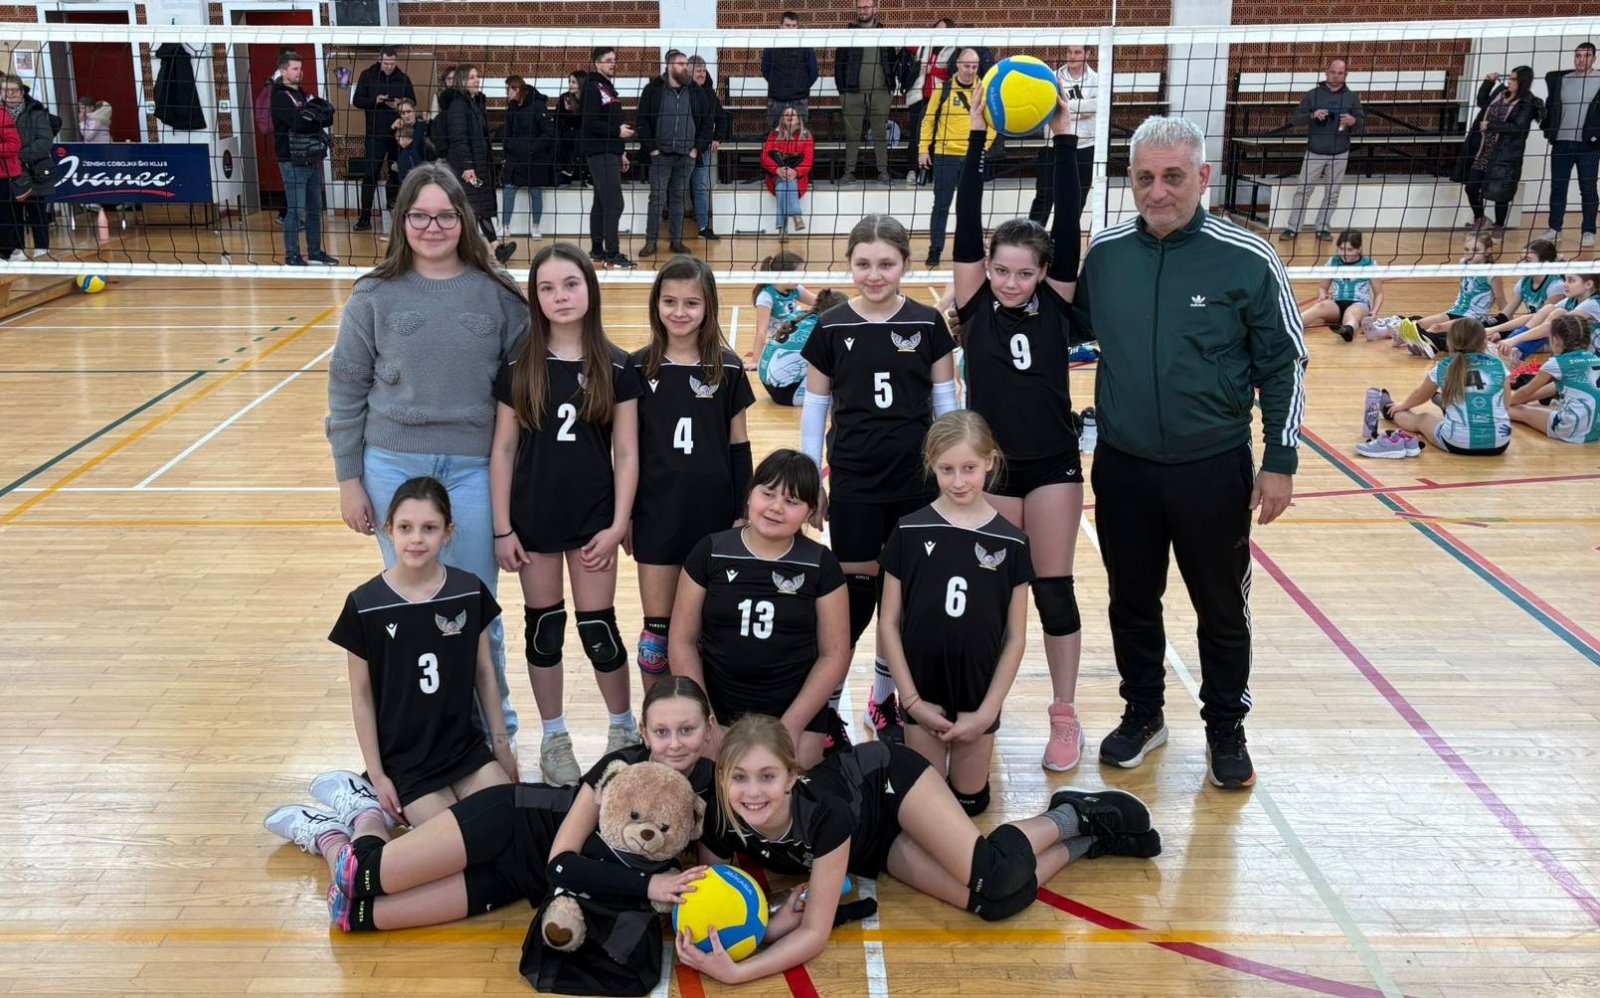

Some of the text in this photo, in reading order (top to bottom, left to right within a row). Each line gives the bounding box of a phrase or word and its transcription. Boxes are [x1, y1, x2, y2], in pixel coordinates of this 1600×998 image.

[54, 155, 175, 187] Ivanec
[1010, 333, 1032, 371] 9
[874, 371, 894, 409] 5
[556, 403, 577, 442] 2
[673, 416, 694, 455] 4
[944, 576, 968, 618] 6
[737, 598, 775, 640] 13
[418, 652, 440, 694] 3
